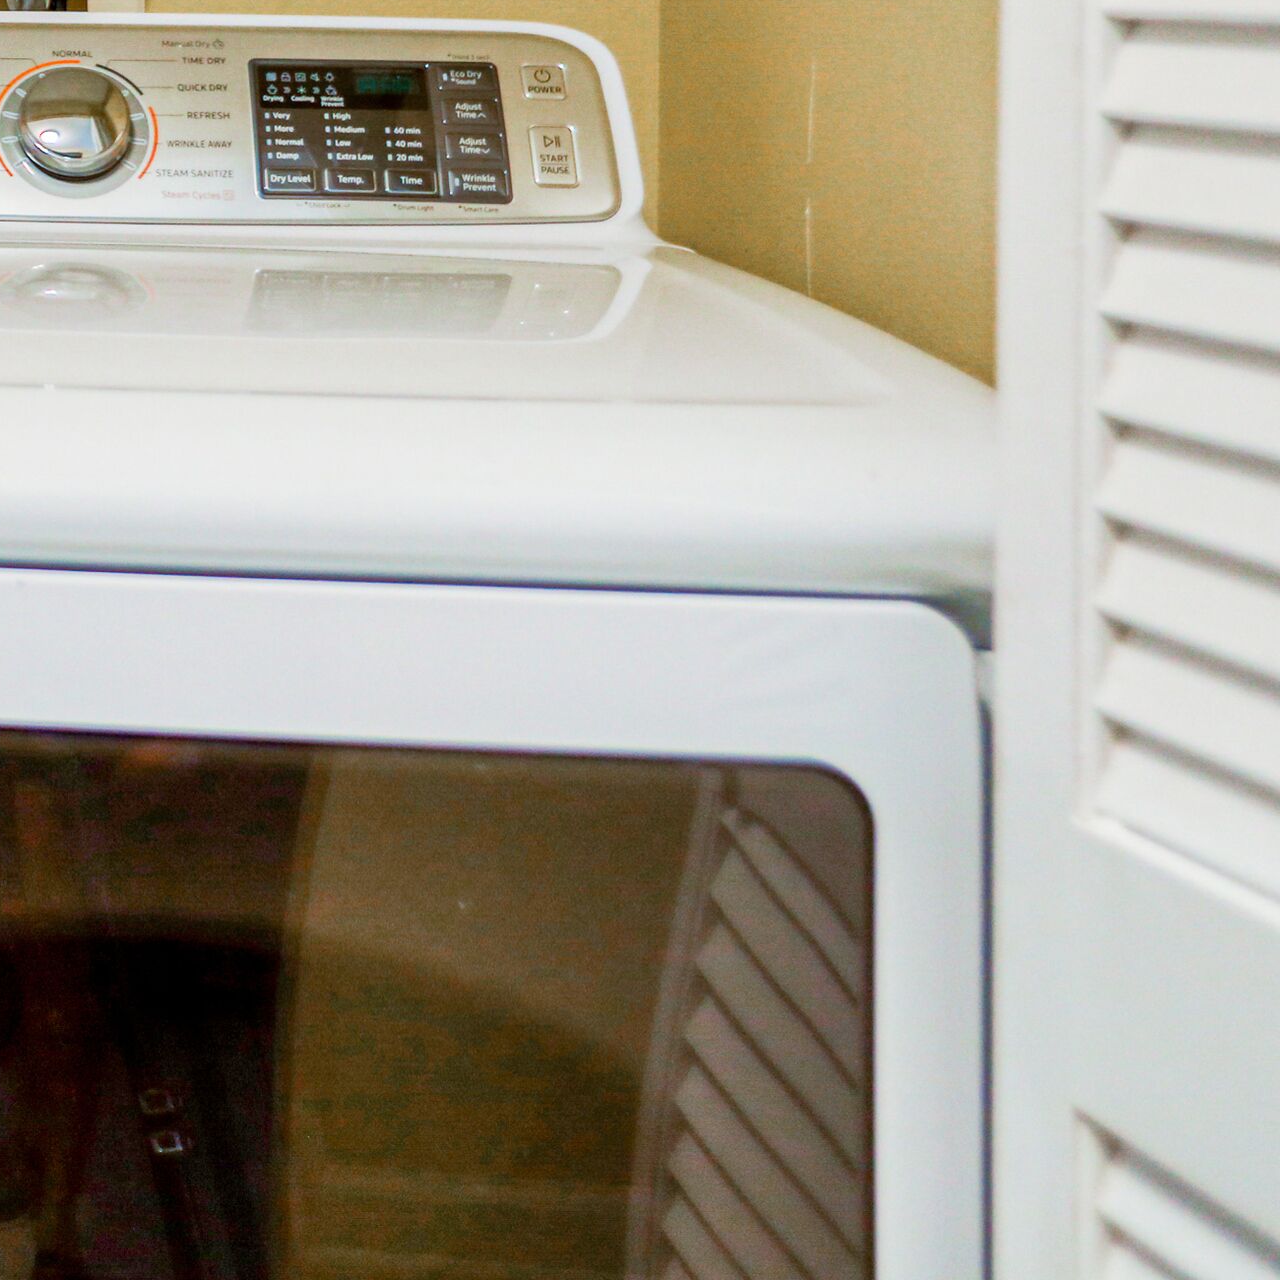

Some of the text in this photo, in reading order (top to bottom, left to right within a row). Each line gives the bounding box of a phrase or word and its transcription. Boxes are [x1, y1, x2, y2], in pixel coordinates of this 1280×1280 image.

[161, 40, 210, 49] Manual Dry
[52, 50, 93, 58] NORMAL
[467, 70, 482, 79] Dry
[177, 84, 207, 92] QUICK
[455, 103, 482, 111] Adjust
[186, 111, 230, 119] REFRESH
[272, 112, 291, 120] Very
[456, 111, 477, 119] Time
[167, 140, 232, 148] WRINKLE AWAY
[275, 138, 304, 146] Normal
[459, 137, 487, 146] Adjust
[460, 145, 481, 154] Time
[276, 152, 299, 160] Damp
[156, 169, 234, 178] STEAM SANITIZE
[541, 166, 569, 174] PAUSE
[270, 174, 311, 184] Dry Level
[337, 175, 364, 184] Temp.
[400, 176, 423, 184] Time
[462, 174, 496, 183] Wrinkle
[462, 182, 497, 192] Prevent
[161, 190, 221, 200] Steam Cycles
